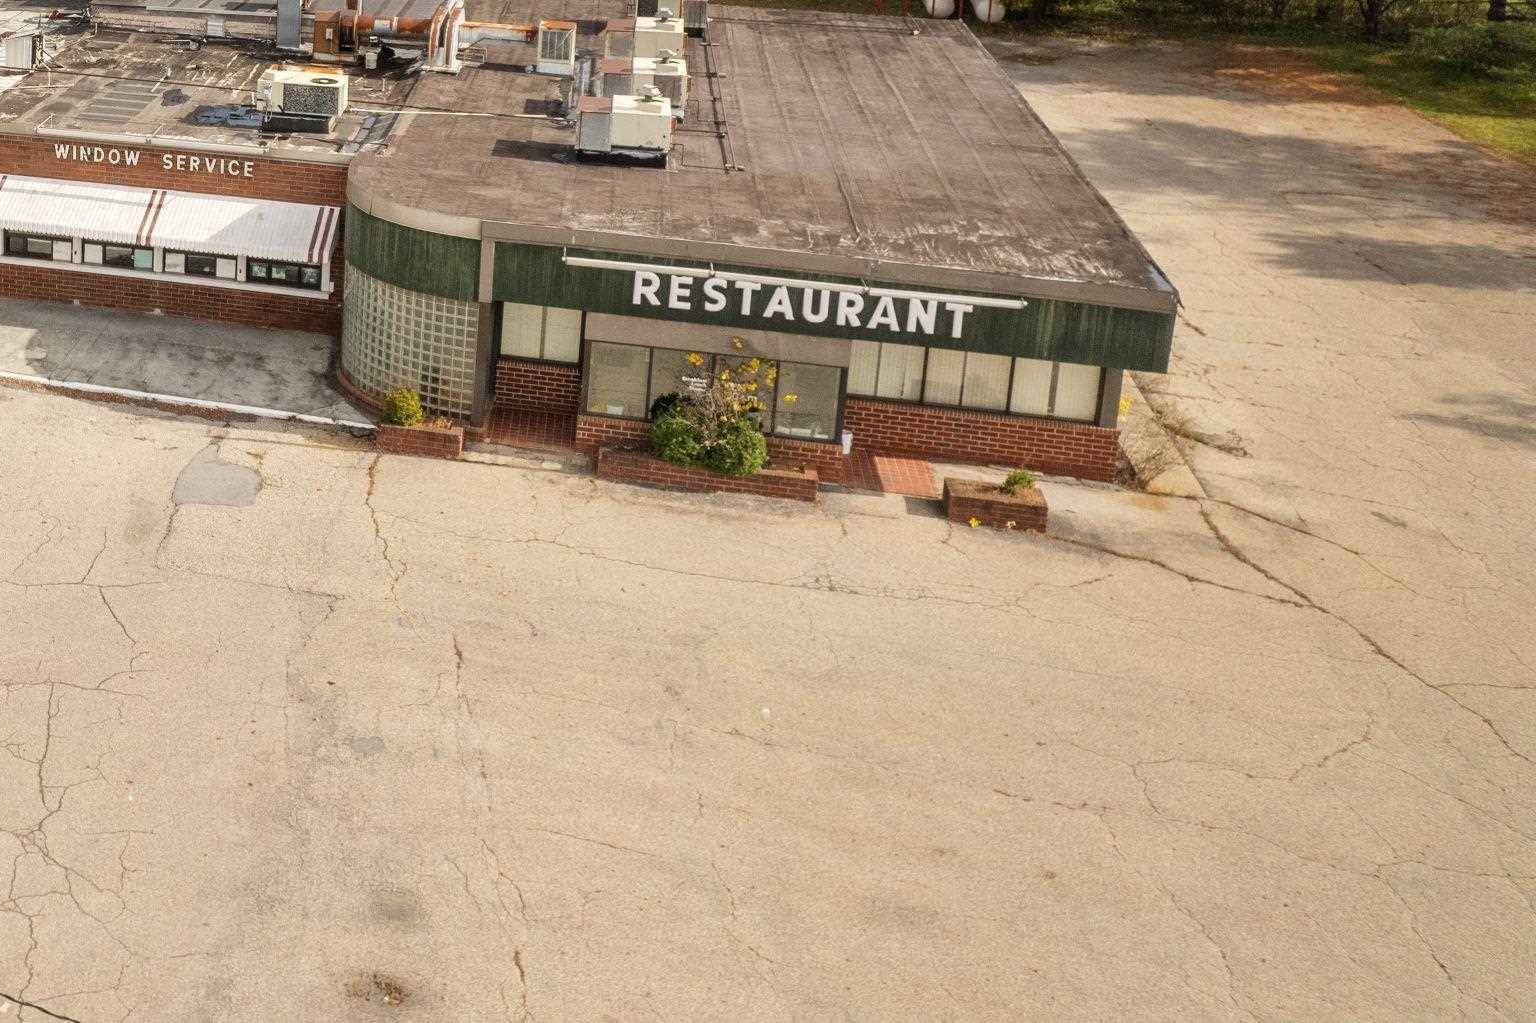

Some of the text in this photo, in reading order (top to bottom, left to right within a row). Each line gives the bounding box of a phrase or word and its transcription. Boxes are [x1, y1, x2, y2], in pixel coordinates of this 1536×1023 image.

[54, 143, 254, 177] WINDOW SERVICE
[632, 270, 973, 339] RESTAURANT
